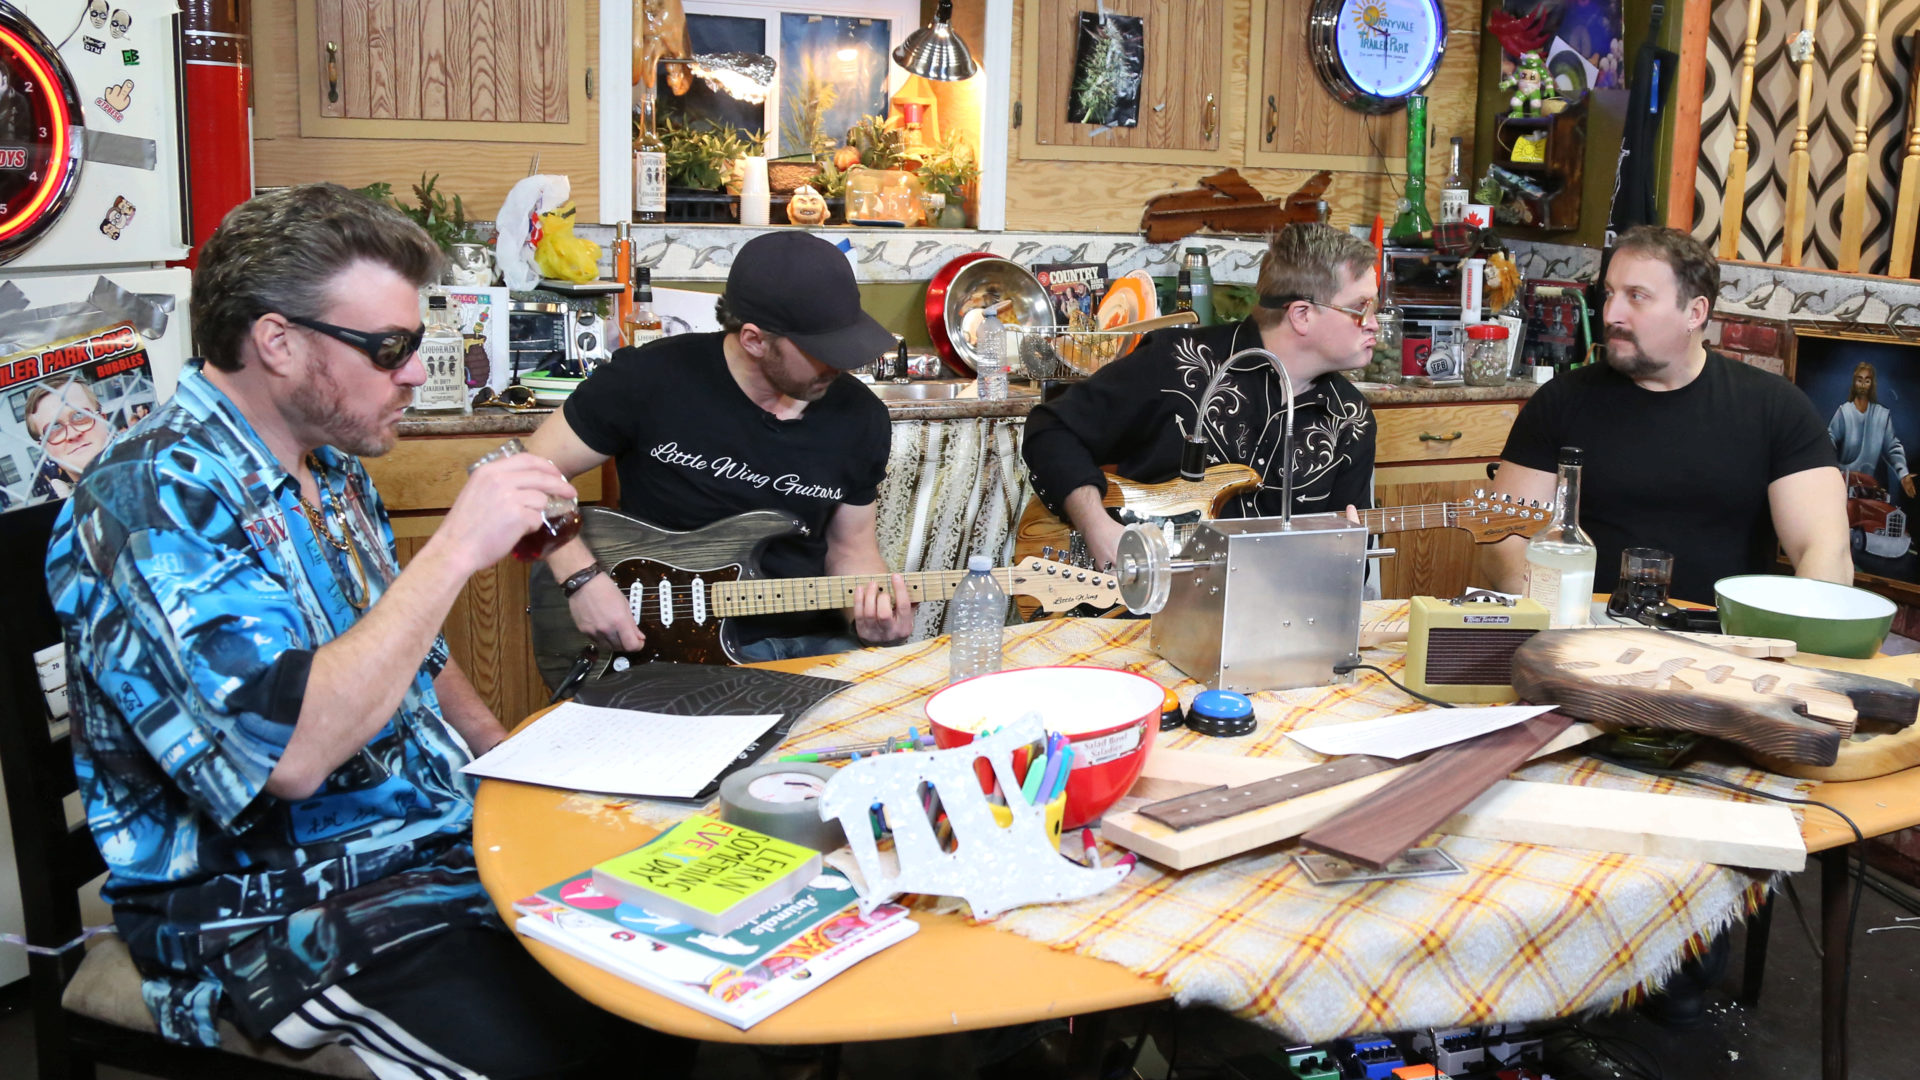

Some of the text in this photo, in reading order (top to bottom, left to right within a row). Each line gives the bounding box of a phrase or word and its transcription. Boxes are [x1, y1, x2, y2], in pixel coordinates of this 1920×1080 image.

[1390, 36, 1409, 54] PARK
[24, 81, 33, 93] 2
[39, 127, 47, 138] 3
[29, 171, 38, 182] 4
[0, 203, 8, 215] 5
[1049, 266, 1099, 285] COUNTRY
[43, 343, 88, 373] PARK
[93, 327, 134, 358] BOYS
[97, 353, 145, 378] BUBBLES
[650, 442, 843, 500] Little Wing Guitars
[629, 858, 682, 884] DAY
[655, 830, 771, 893] SOMETHING
[713, 847, 797, 895] LEARN
